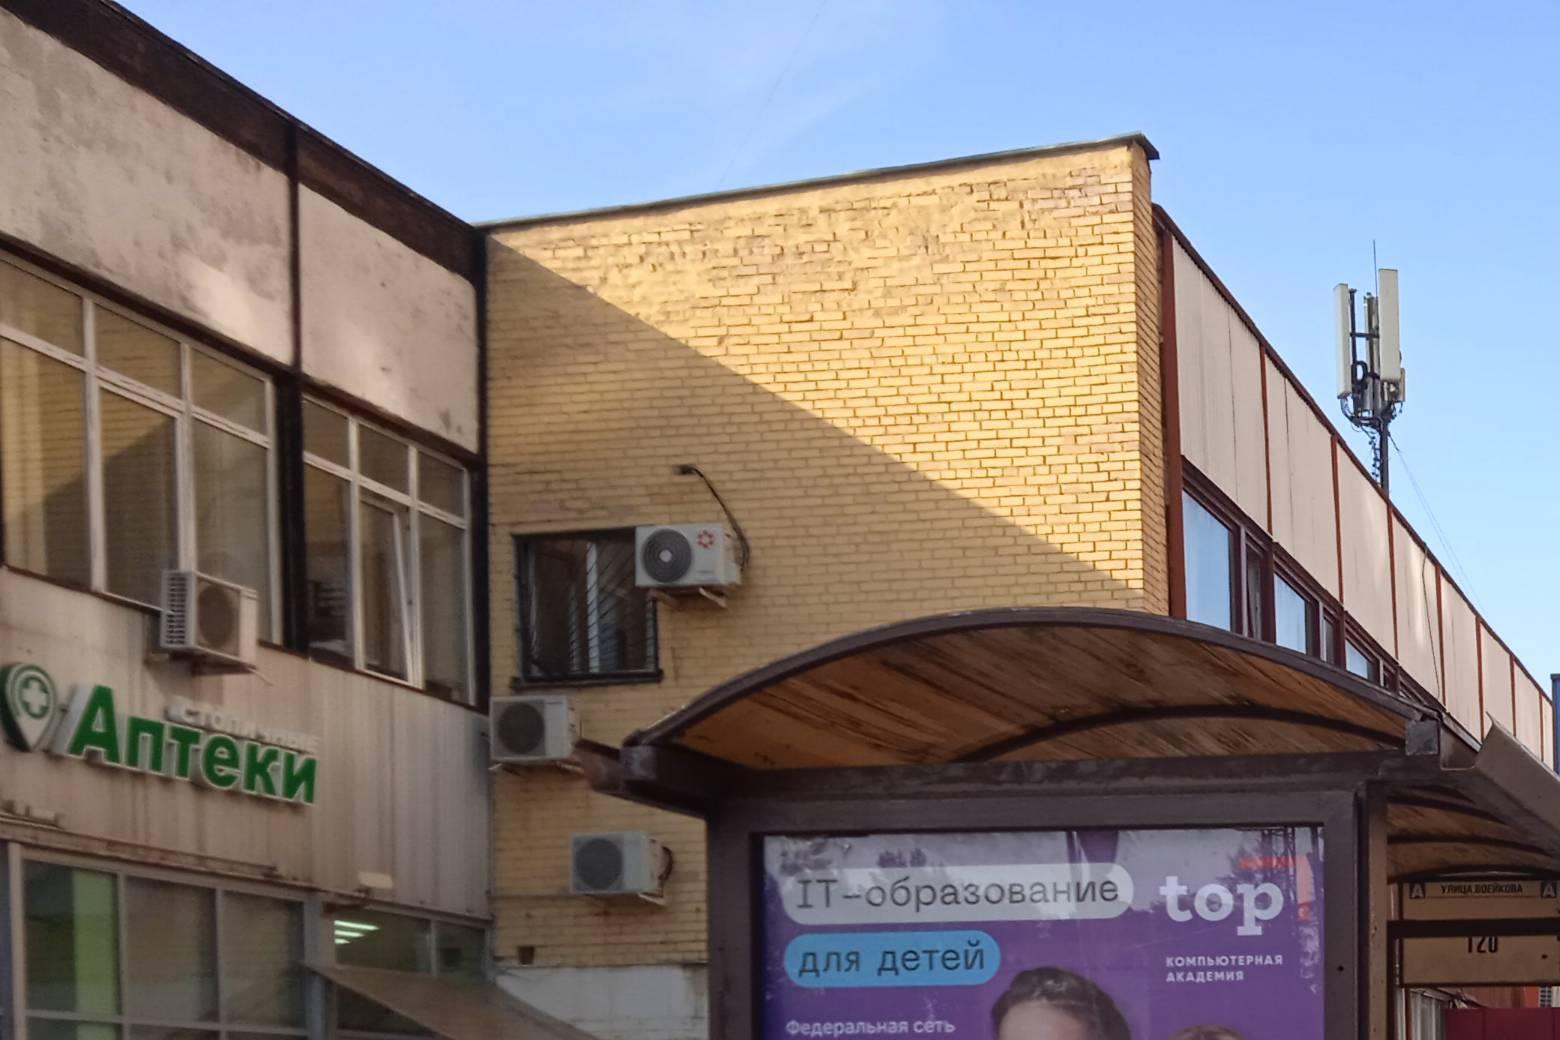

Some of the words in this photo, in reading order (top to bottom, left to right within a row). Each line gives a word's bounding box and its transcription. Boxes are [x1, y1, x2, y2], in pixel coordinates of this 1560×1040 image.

[66, 684, 318, 804] Аптеки
[796, 876, 1119, 913] IT-образование
[1440, 883, 1472, 895] УЛИЦА
[1475, 882, 1523, 894] ВОЕЙКОВА
[1159, 876, 1284, 936] top
[798, 950, 861, 977] для
[876, 940, 985, 976] детей
[1165, 954, 1283, 967] КОМПЬЮТЕРНАЯ
[1165, 971, 1244, 983] АКАДЕМИЯ
[785, 1020, 909, 1038] Федеральная
[913, 1020, 956, 1034] сеть
